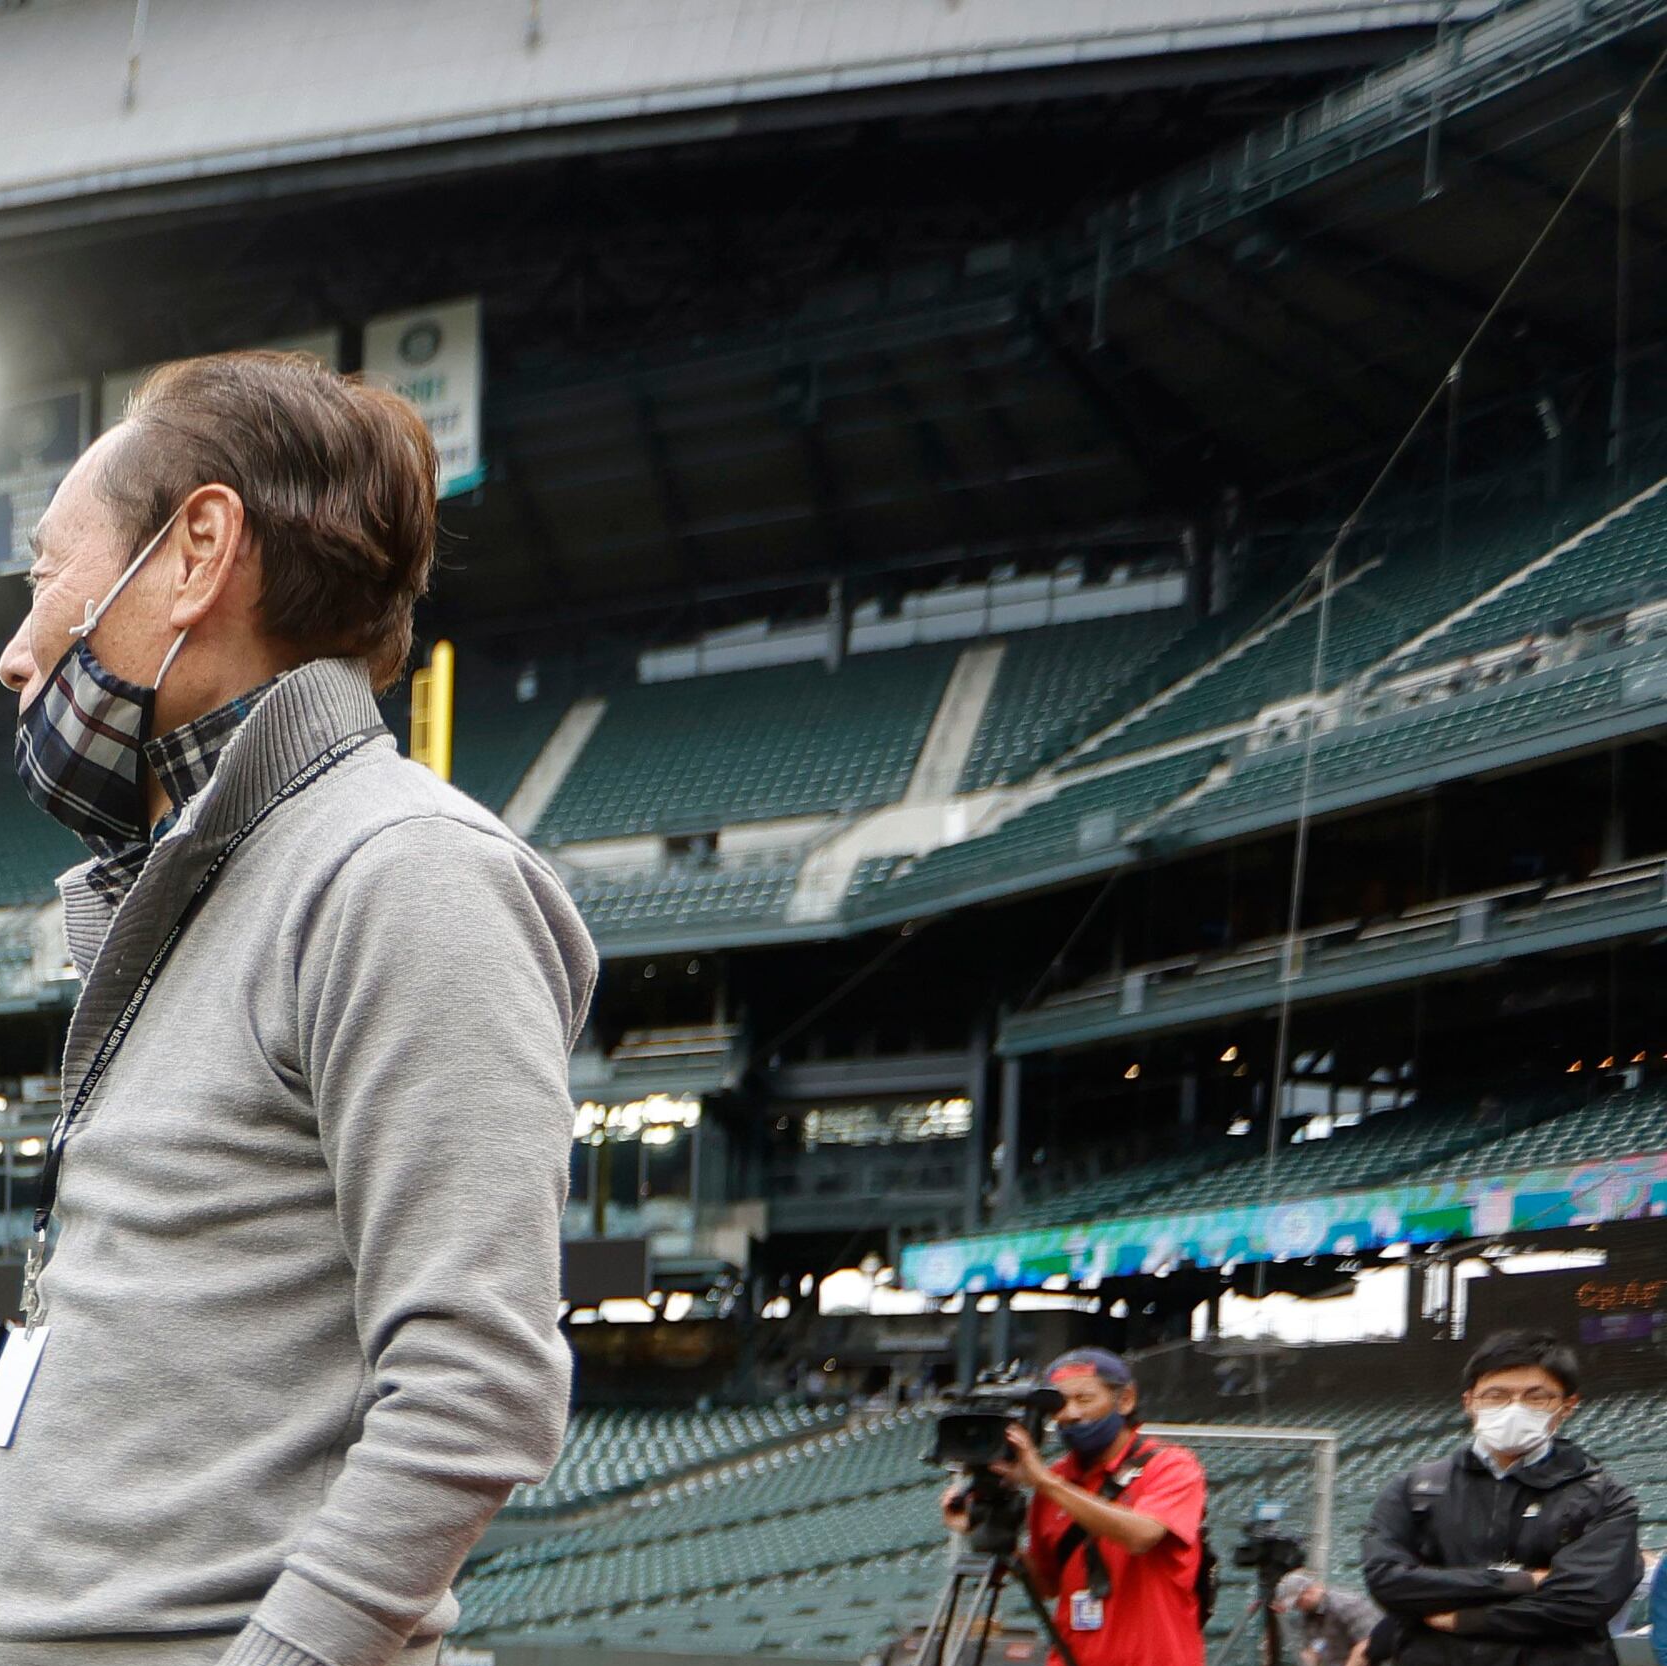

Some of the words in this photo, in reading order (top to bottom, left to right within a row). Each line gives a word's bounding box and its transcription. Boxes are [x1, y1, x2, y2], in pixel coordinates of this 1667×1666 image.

[281, 754, 332, 797] INTENSIVE
[95, 1028, 125, 1072] SUMMER
[118, 976, 151, 1032] INTENSIVE
[147, 925, 181, 976] PROGRAM
